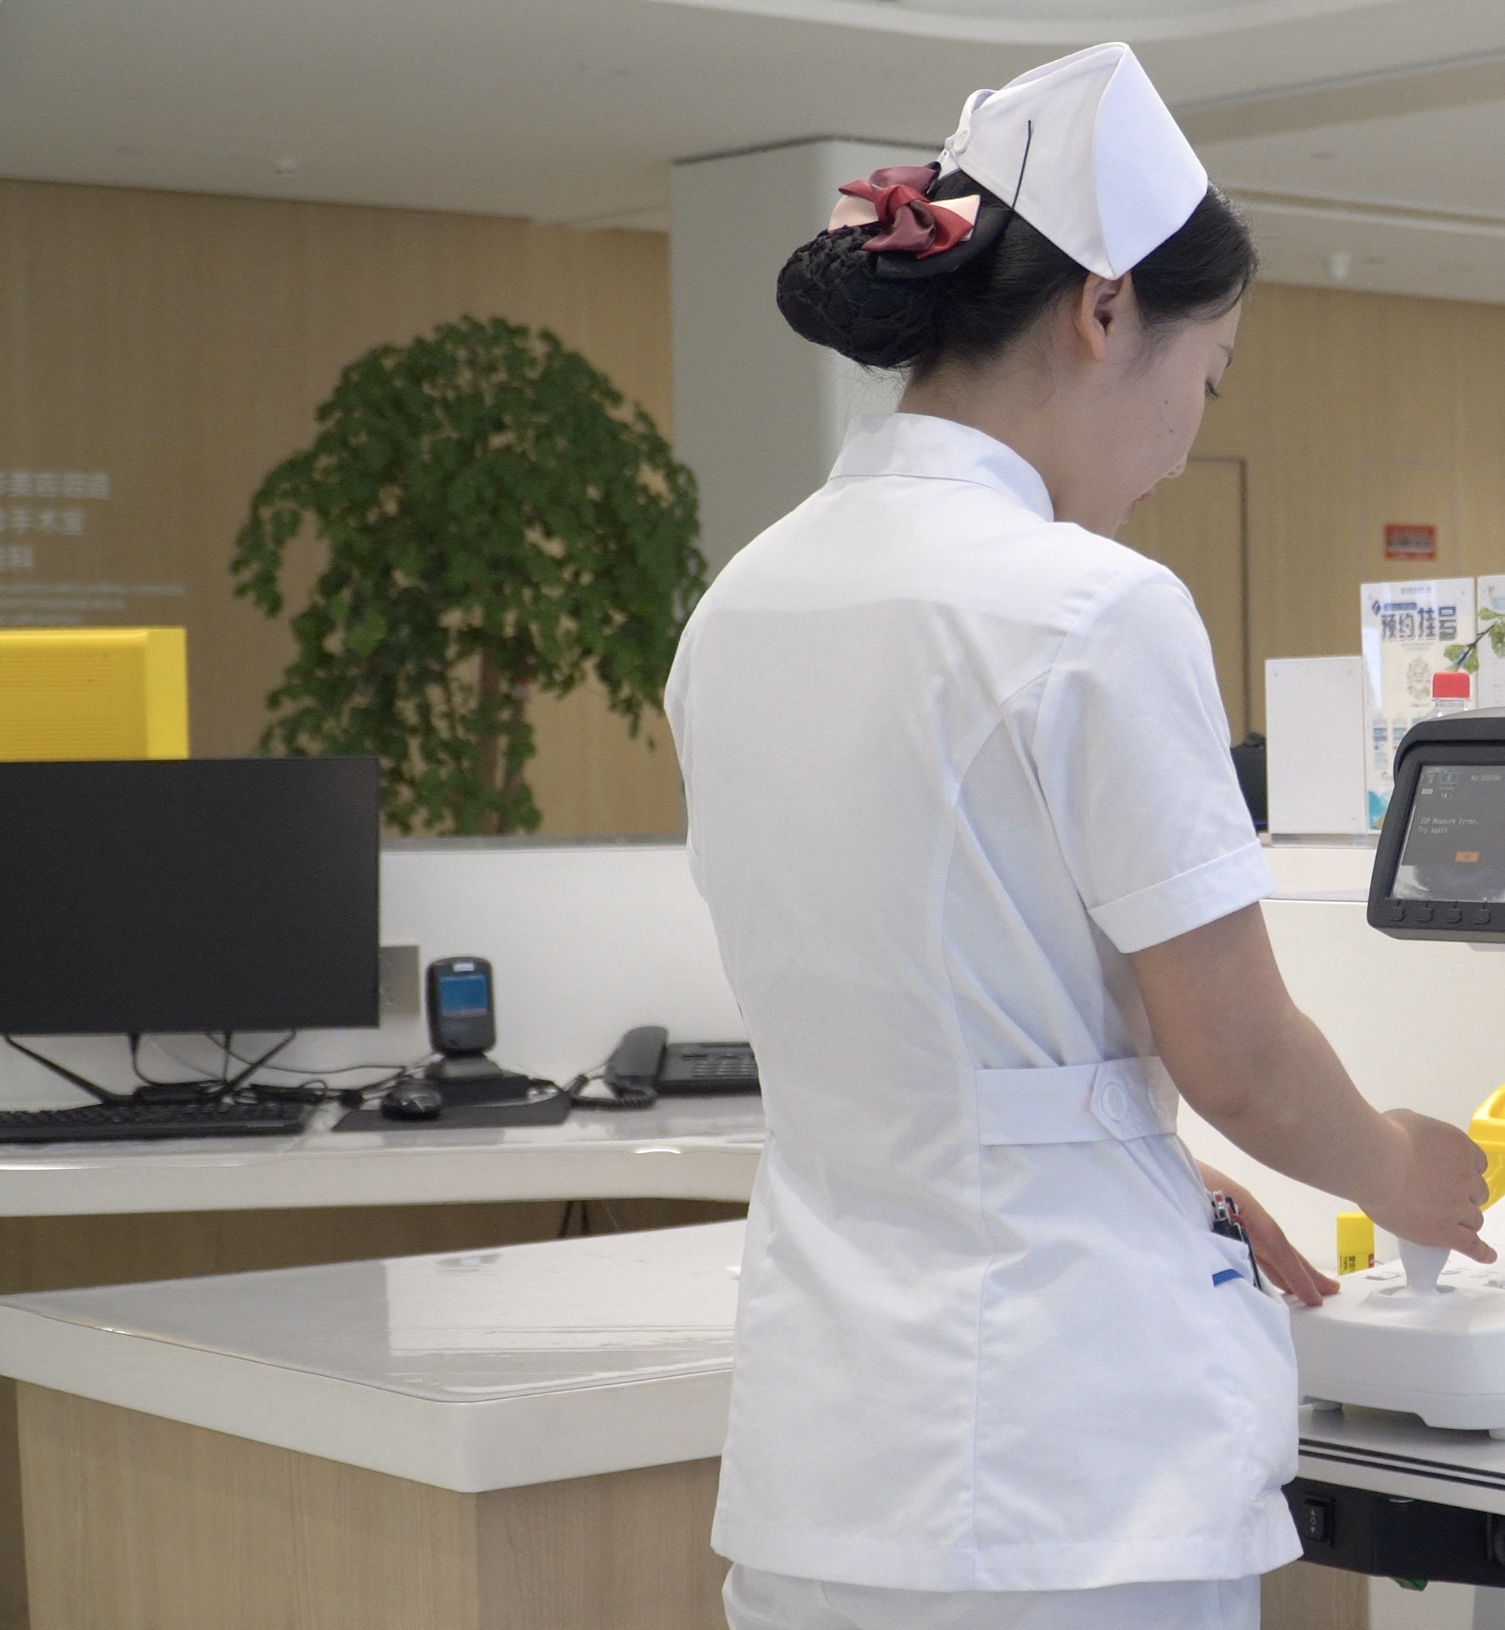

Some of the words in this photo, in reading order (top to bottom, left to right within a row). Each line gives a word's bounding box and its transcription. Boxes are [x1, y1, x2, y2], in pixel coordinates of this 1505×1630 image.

[1380, 606, 1457, 641] 预约挂号
[1432, 818, 1456, 826] Measure
[1418, 826, 1428, 834] Try
